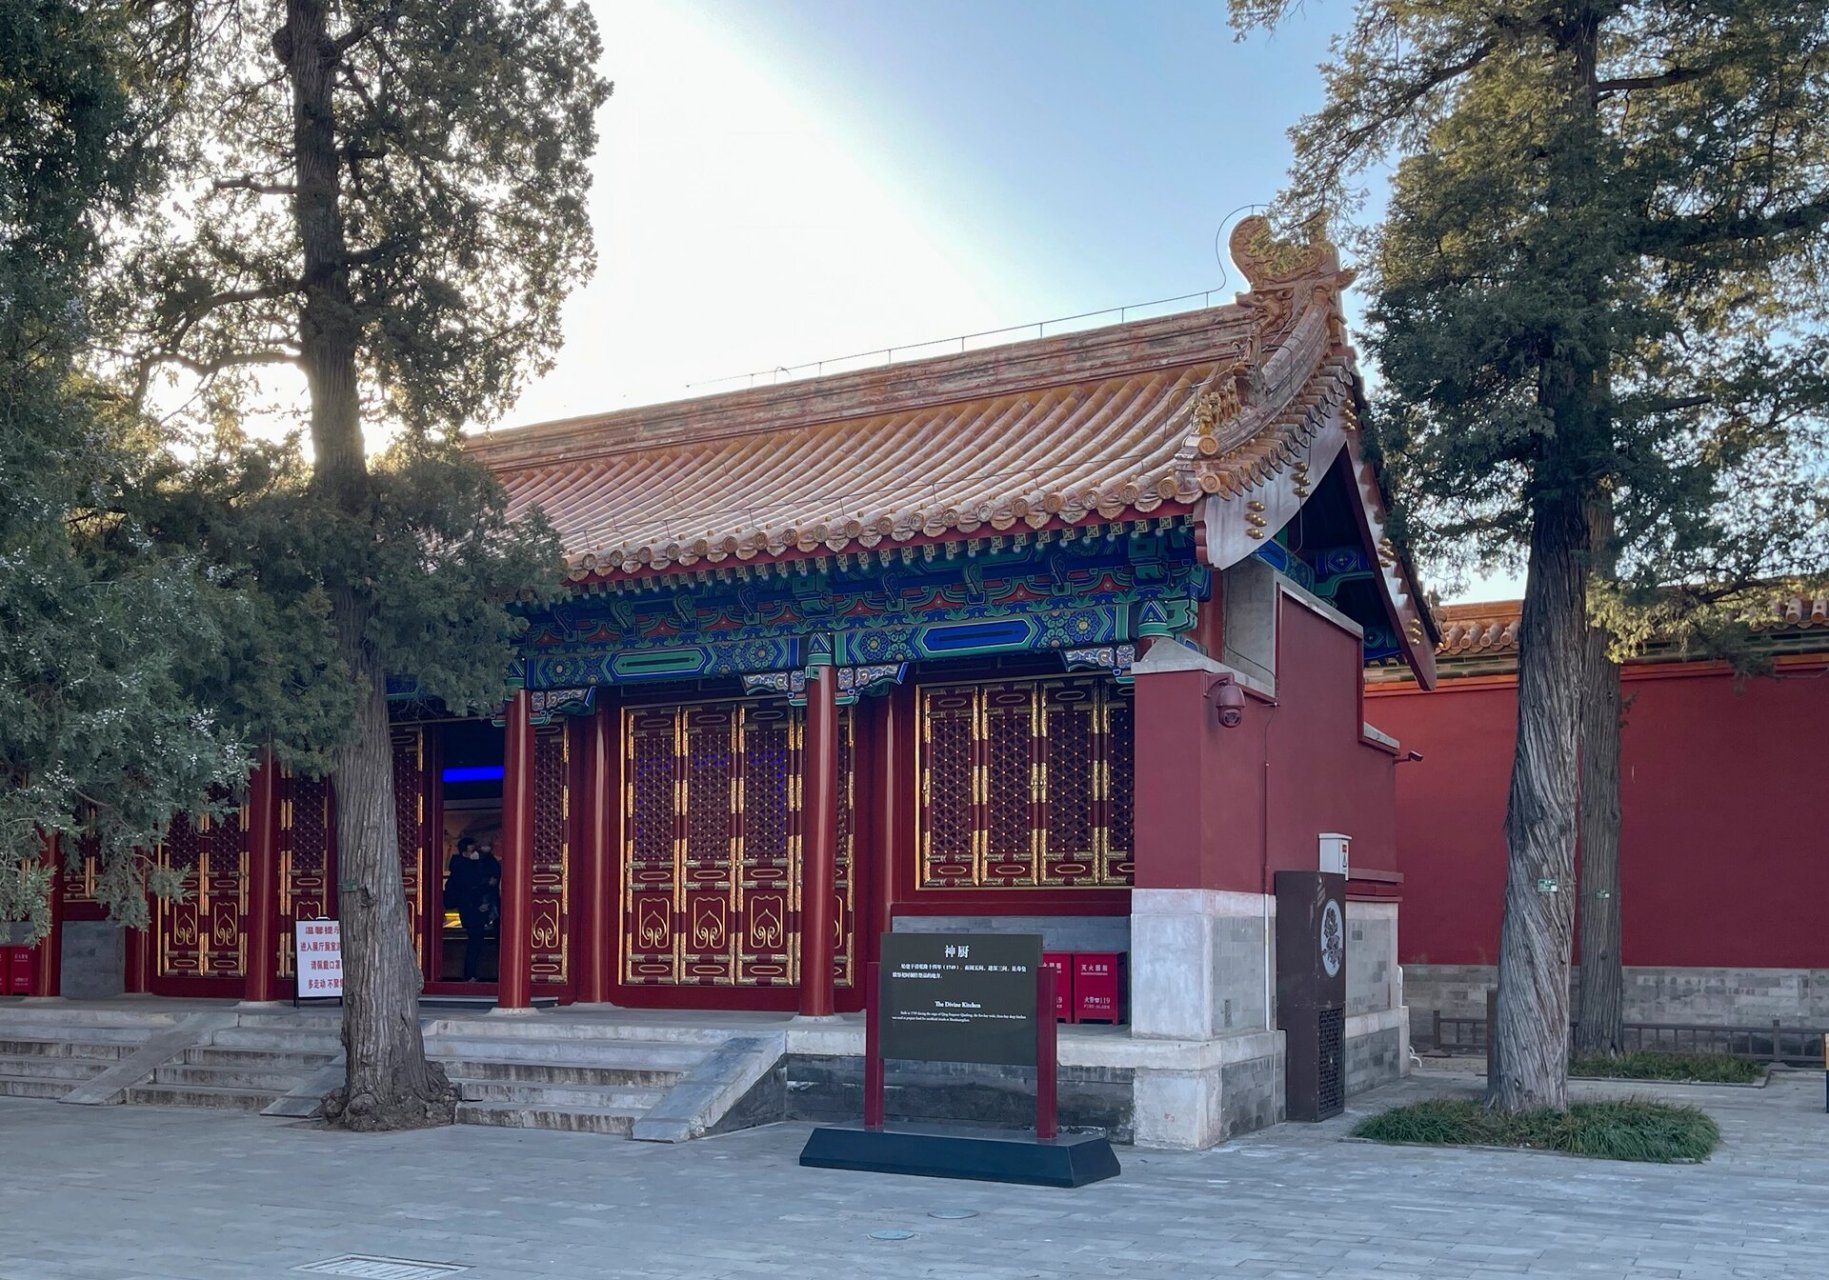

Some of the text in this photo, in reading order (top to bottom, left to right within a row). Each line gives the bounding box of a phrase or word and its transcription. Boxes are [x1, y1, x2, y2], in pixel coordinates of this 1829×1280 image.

[944, 944, 970, 958] 神厨
[934, 1000, 944, 1008] The
[961, 1001, 981, 1009] Kitchen
